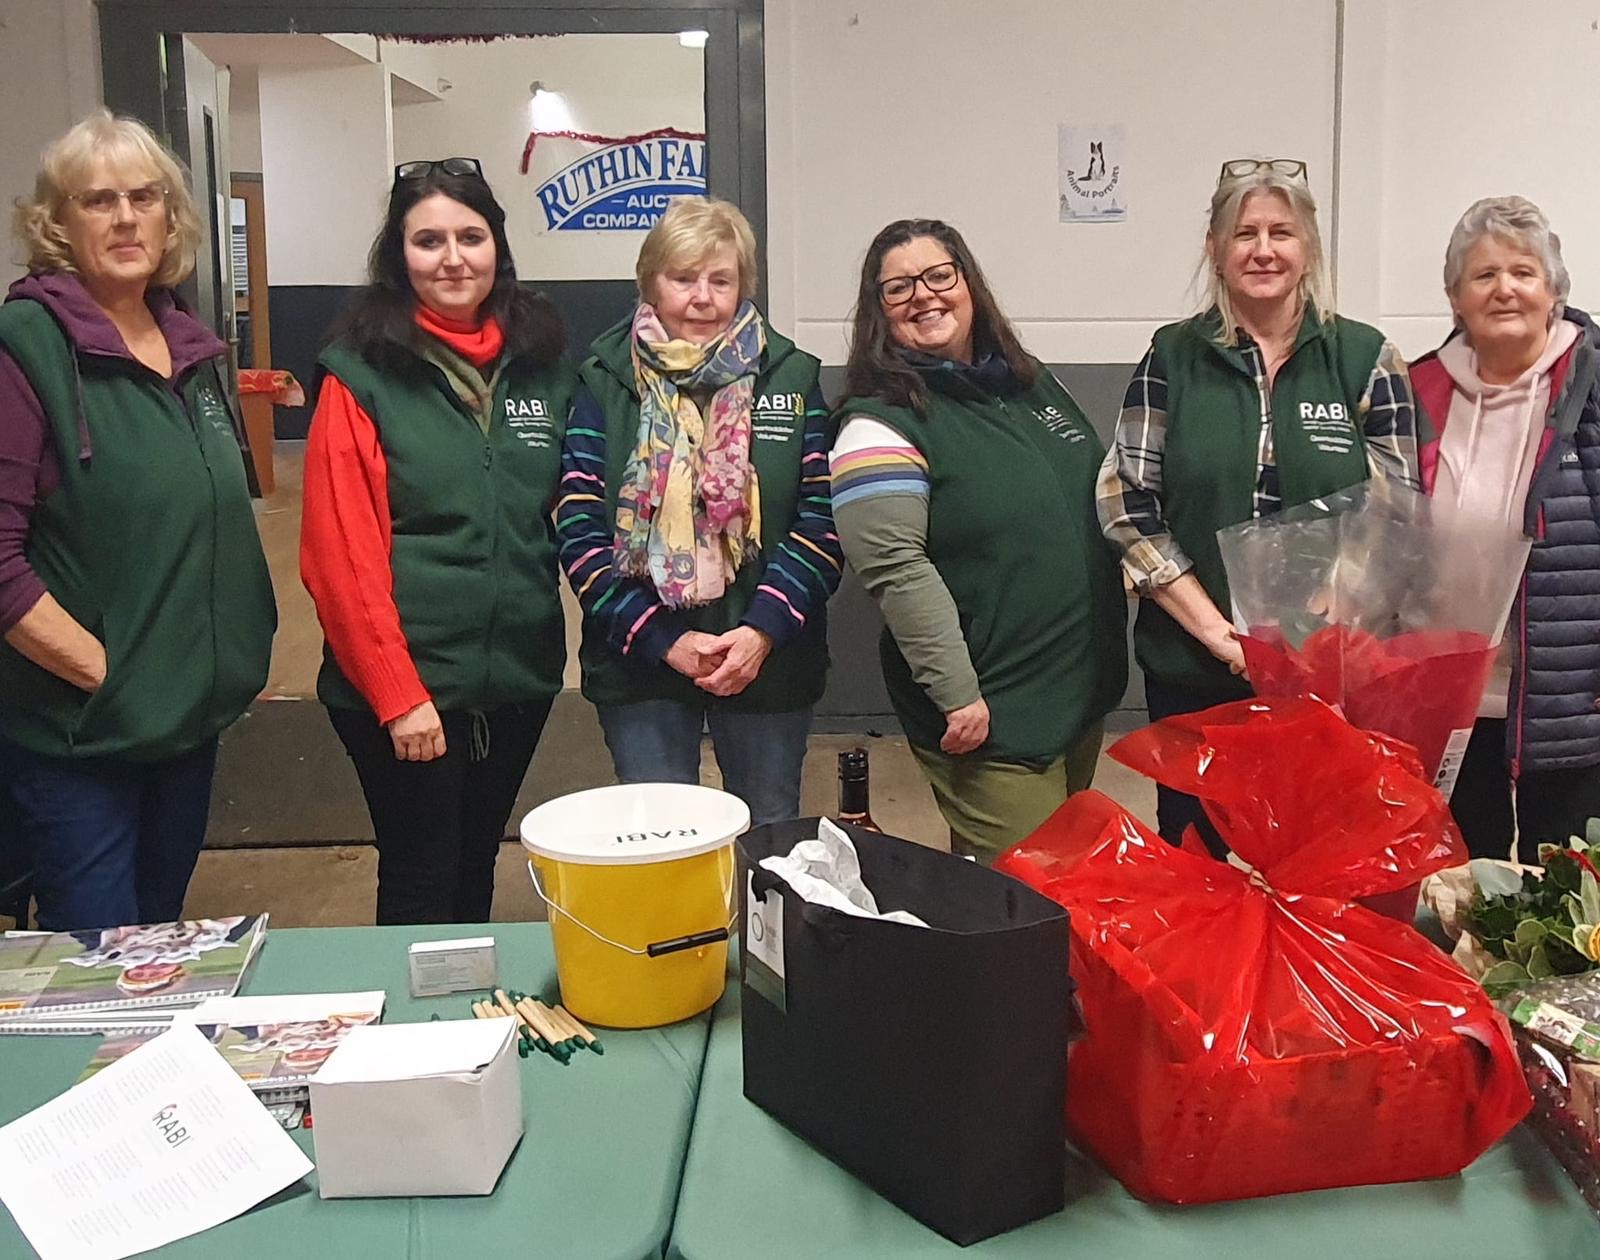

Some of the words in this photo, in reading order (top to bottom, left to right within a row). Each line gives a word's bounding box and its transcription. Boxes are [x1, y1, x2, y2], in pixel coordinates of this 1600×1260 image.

[536, 143, 652, 230] RUTHIN
[1066, 169, 1090, 198] Animal
[1092, 165, 1119, 198] Portraits
[504, 398, 548, 416] RABI
[1299, 402, 1349, 421] RABI
[616, 828, 698, 843] RABI
[152, 1104, 192, 1148] RABI
